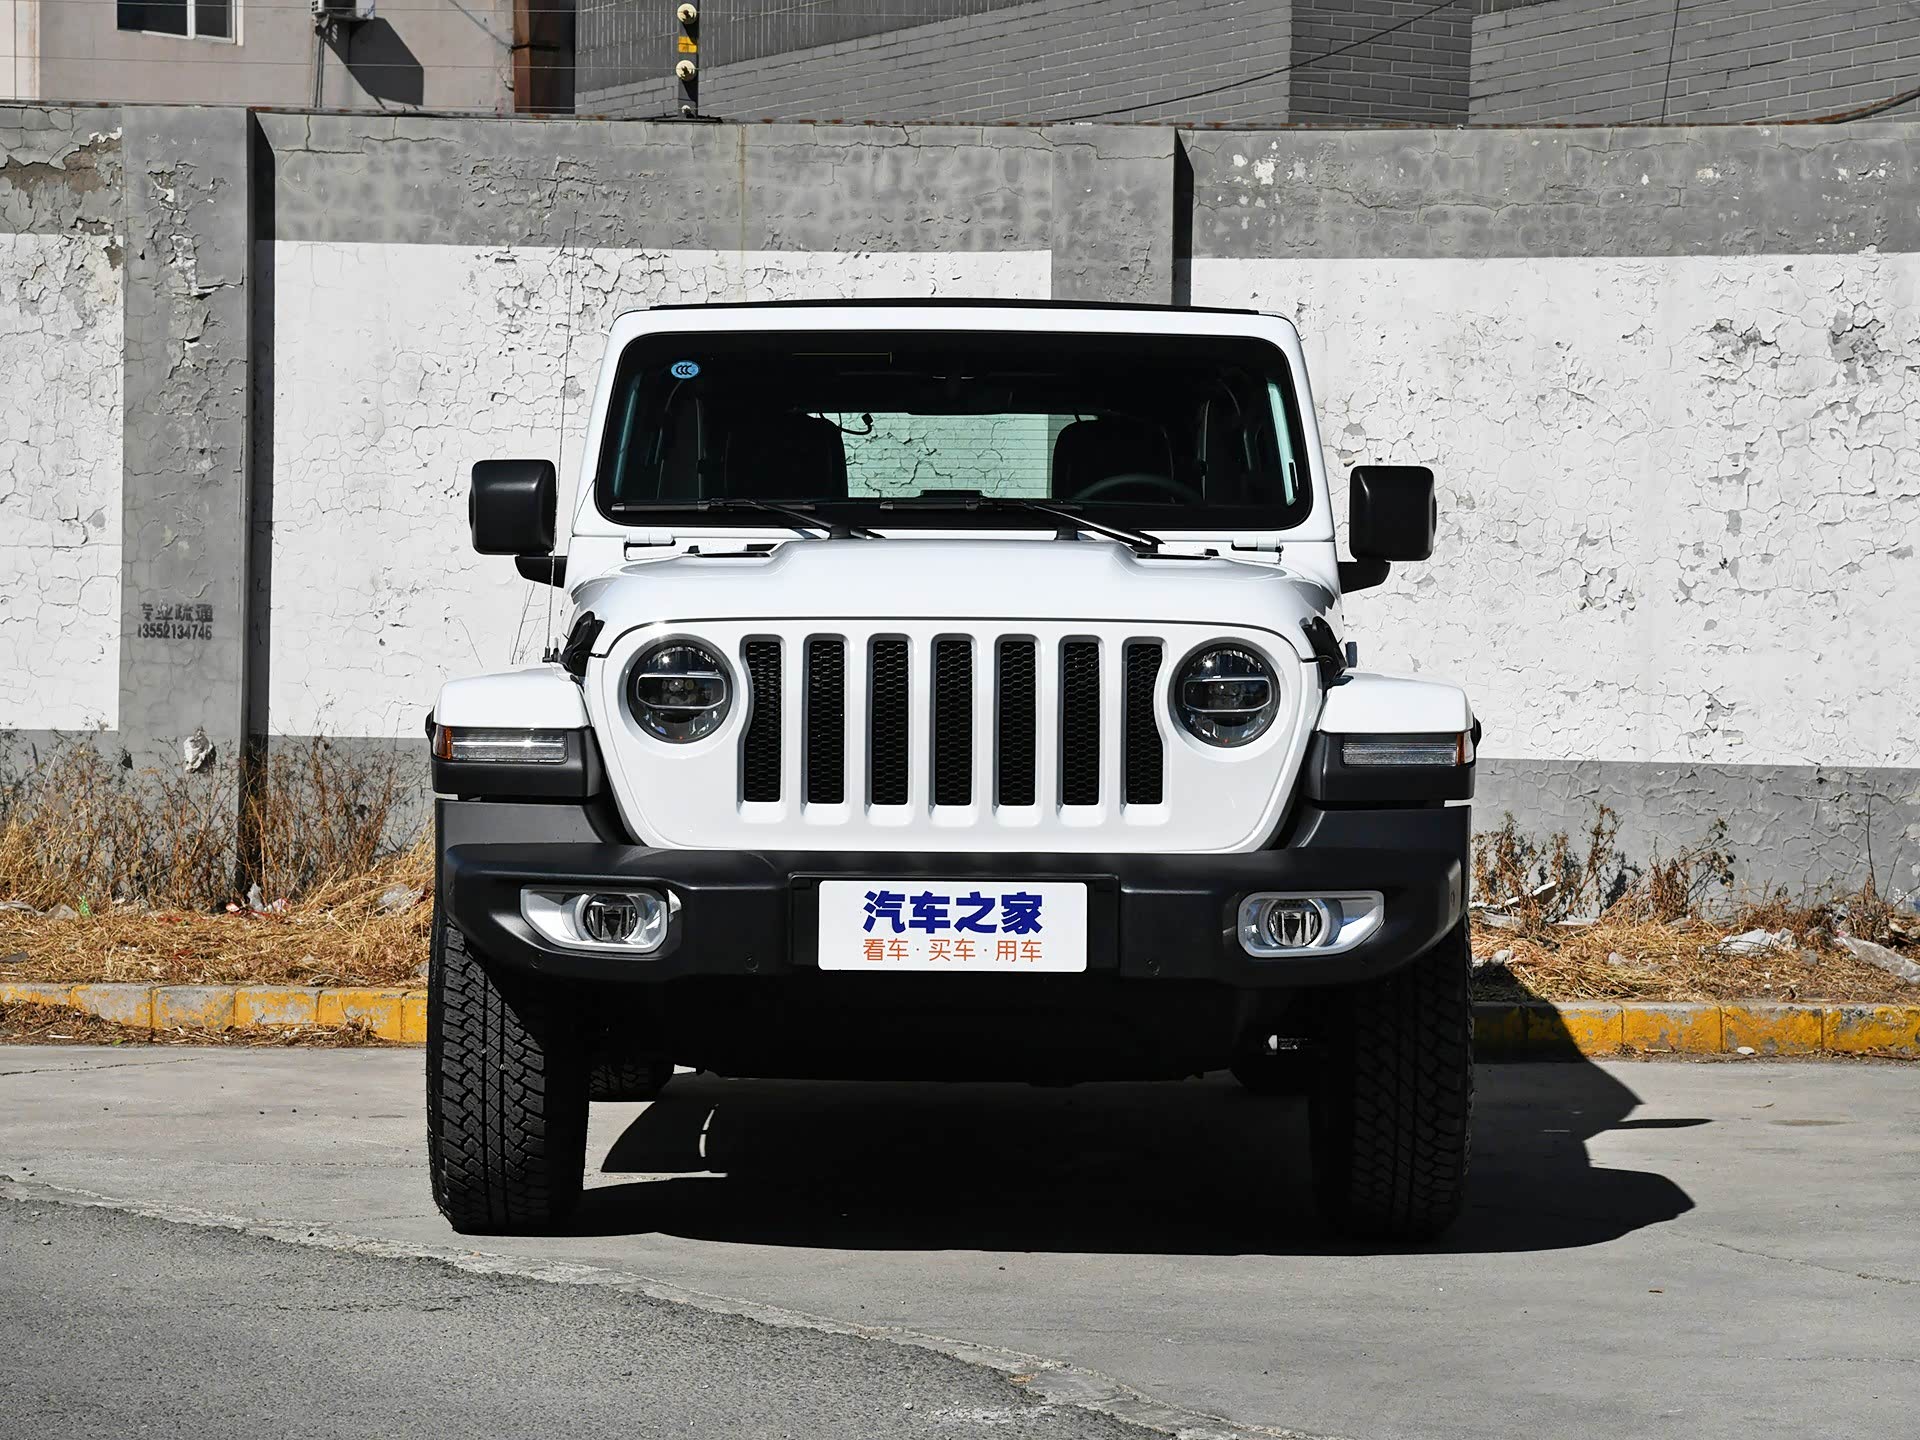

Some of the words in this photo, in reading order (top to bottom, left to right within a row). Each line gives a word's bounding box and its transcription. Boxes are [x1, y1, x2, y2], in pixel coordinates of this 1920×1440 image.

[138, 622, 212, 640] 13552134746
[862, 890, 1043, 934] 汽车之家
